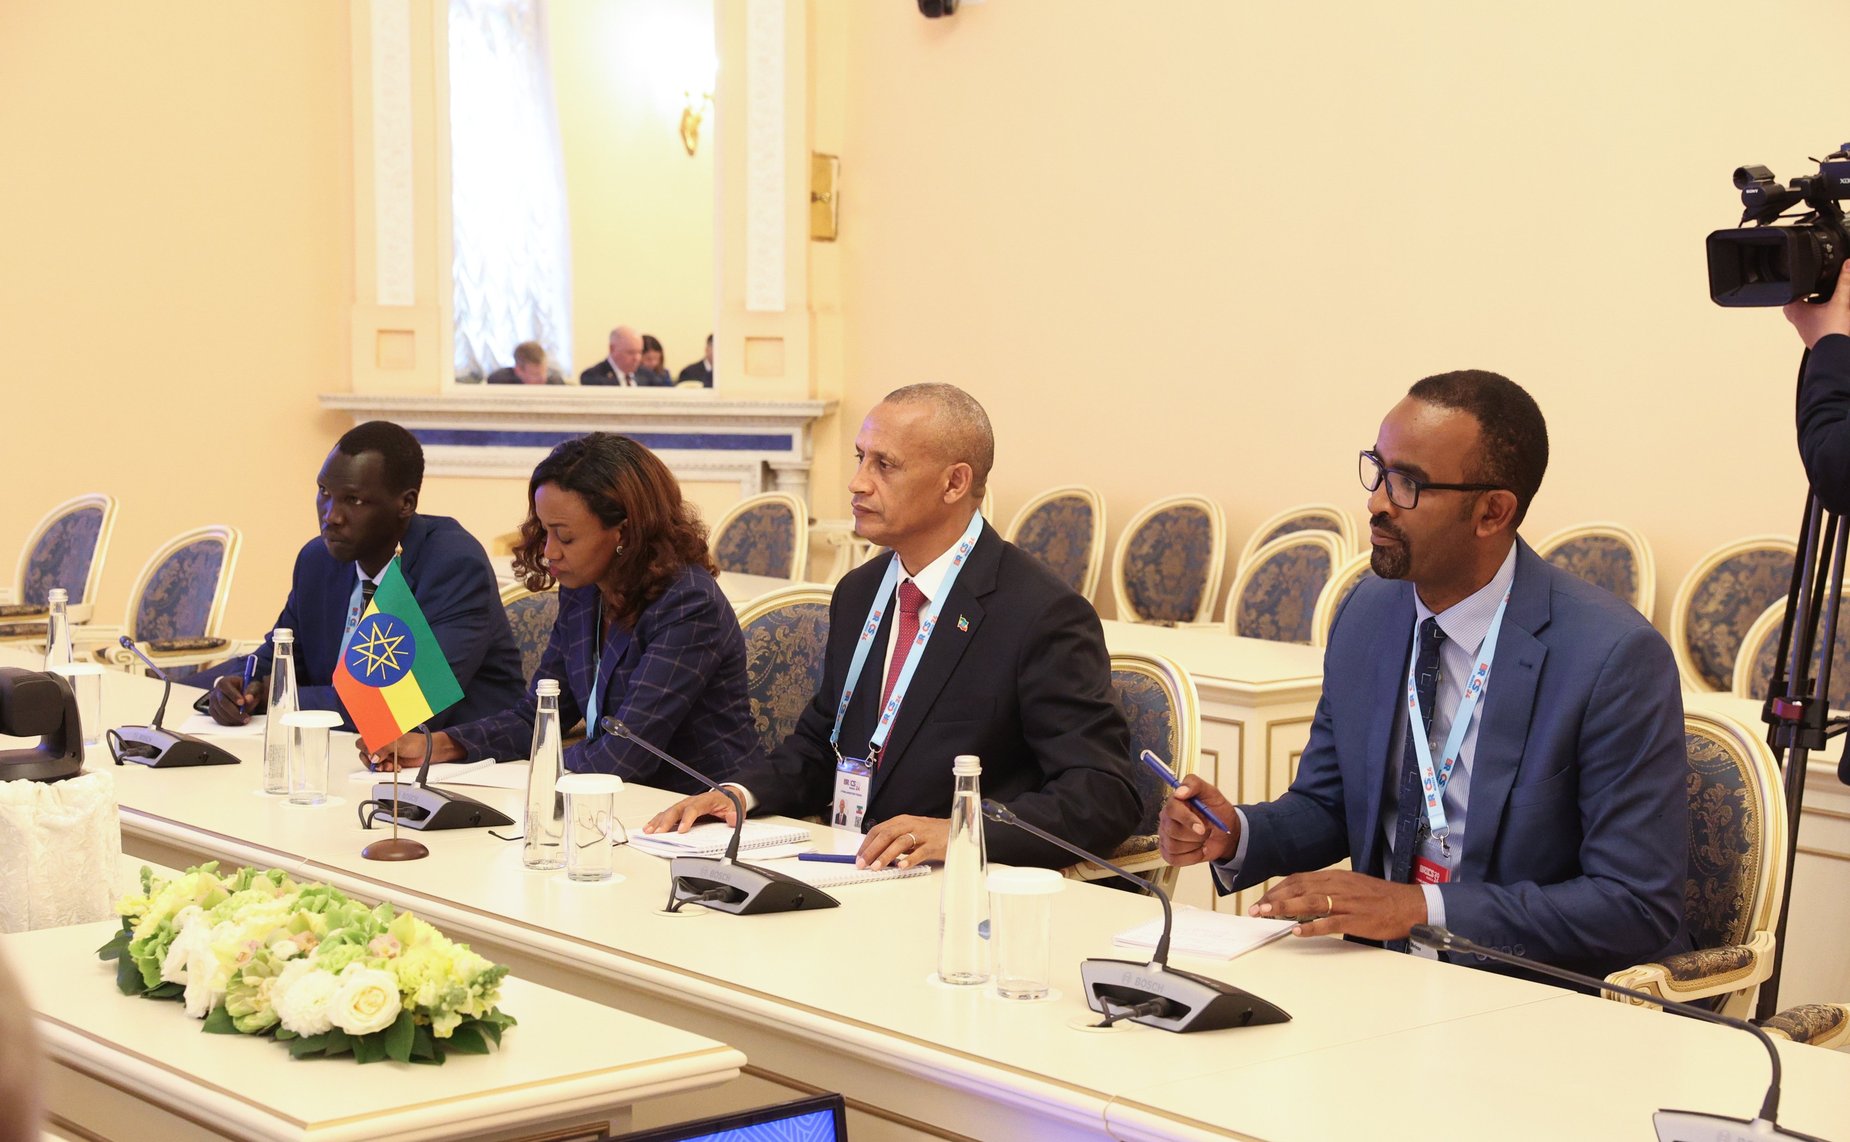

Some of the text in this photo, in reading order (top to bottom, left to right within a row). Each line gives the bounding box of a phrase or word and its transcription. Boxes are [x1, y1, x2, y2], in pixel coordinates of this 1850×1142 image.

[952, 542, 969, 567] BRCS
[867, 610, 882, 636] BRCS
[916, 619, 932, 645] BRCS
[1472, 663, 1488, 692] BRCS
[881, 700, 896, 725] BRCS
[1438, 758, 1454, 788] BRCS
[1424, 778, 1437, 807] BRCS
[1134, 976, 1165, 993] BOSCH
